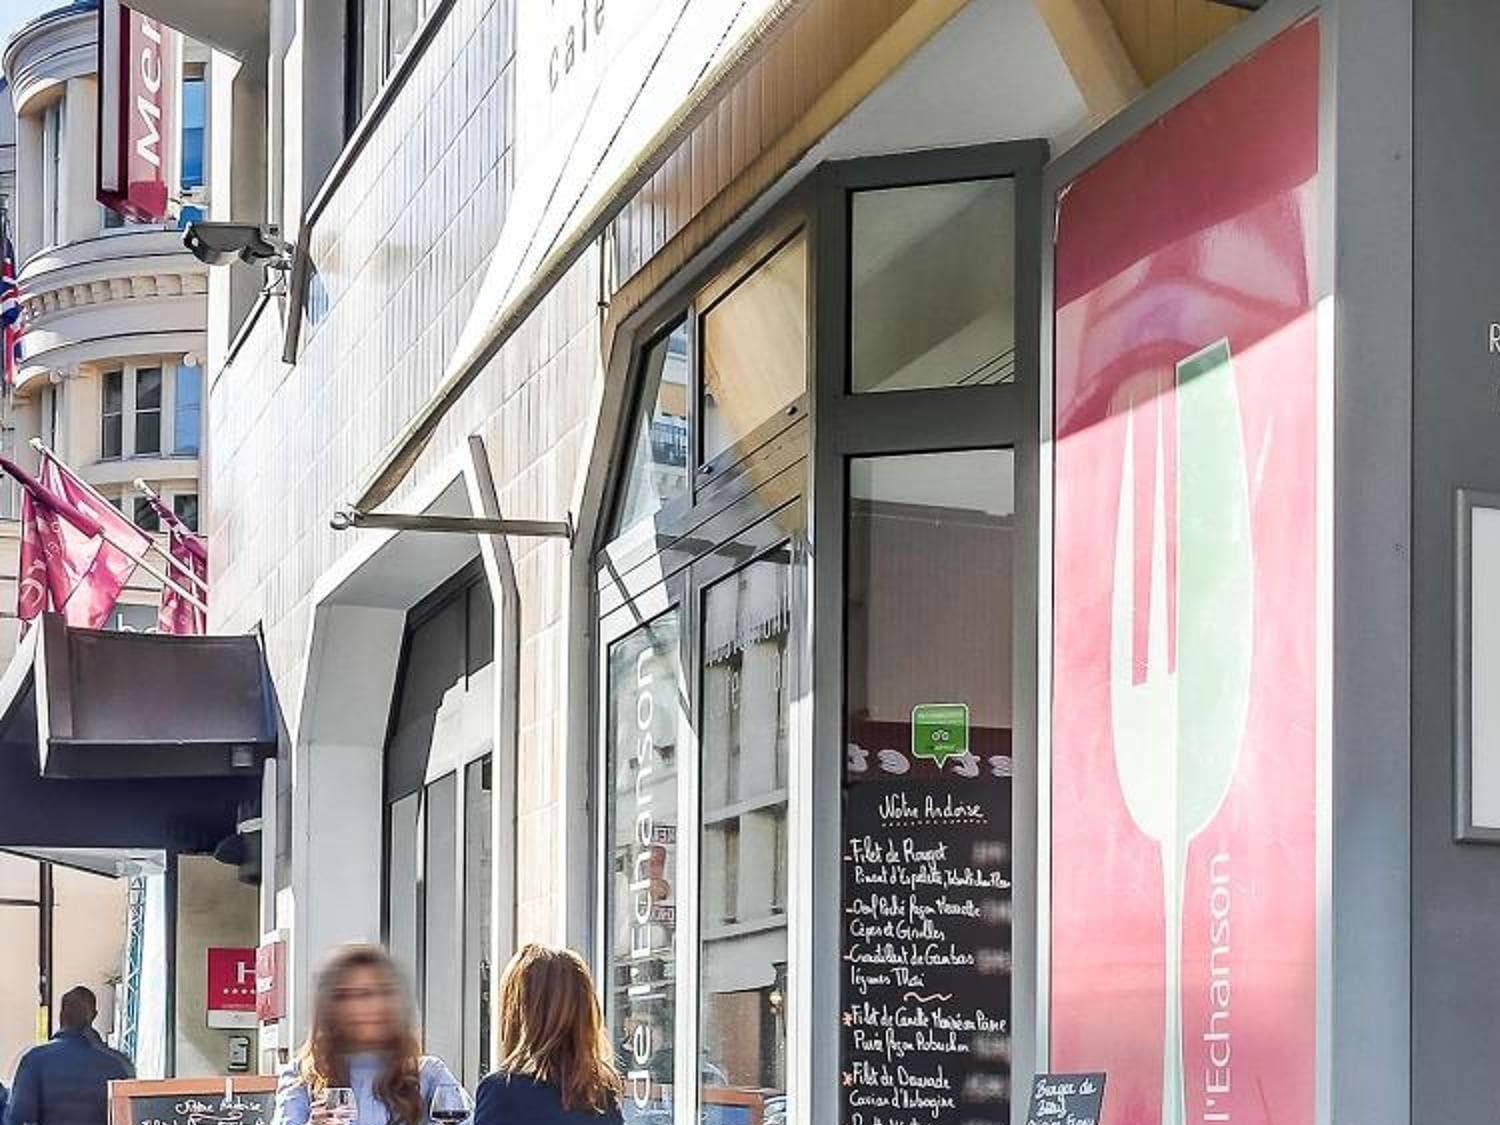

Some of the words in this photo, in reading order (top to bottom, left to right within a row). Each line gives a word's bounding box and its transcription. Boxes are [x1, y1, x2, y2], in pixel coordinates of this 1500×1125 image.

[886, 838, 900, 863] de
[911, 944, 923, 965] de
[1203, 852, 1231, 1121] l'Echanson
[880, 1004, 894, 1027] de
[881, 1064, 894, 1088] de
